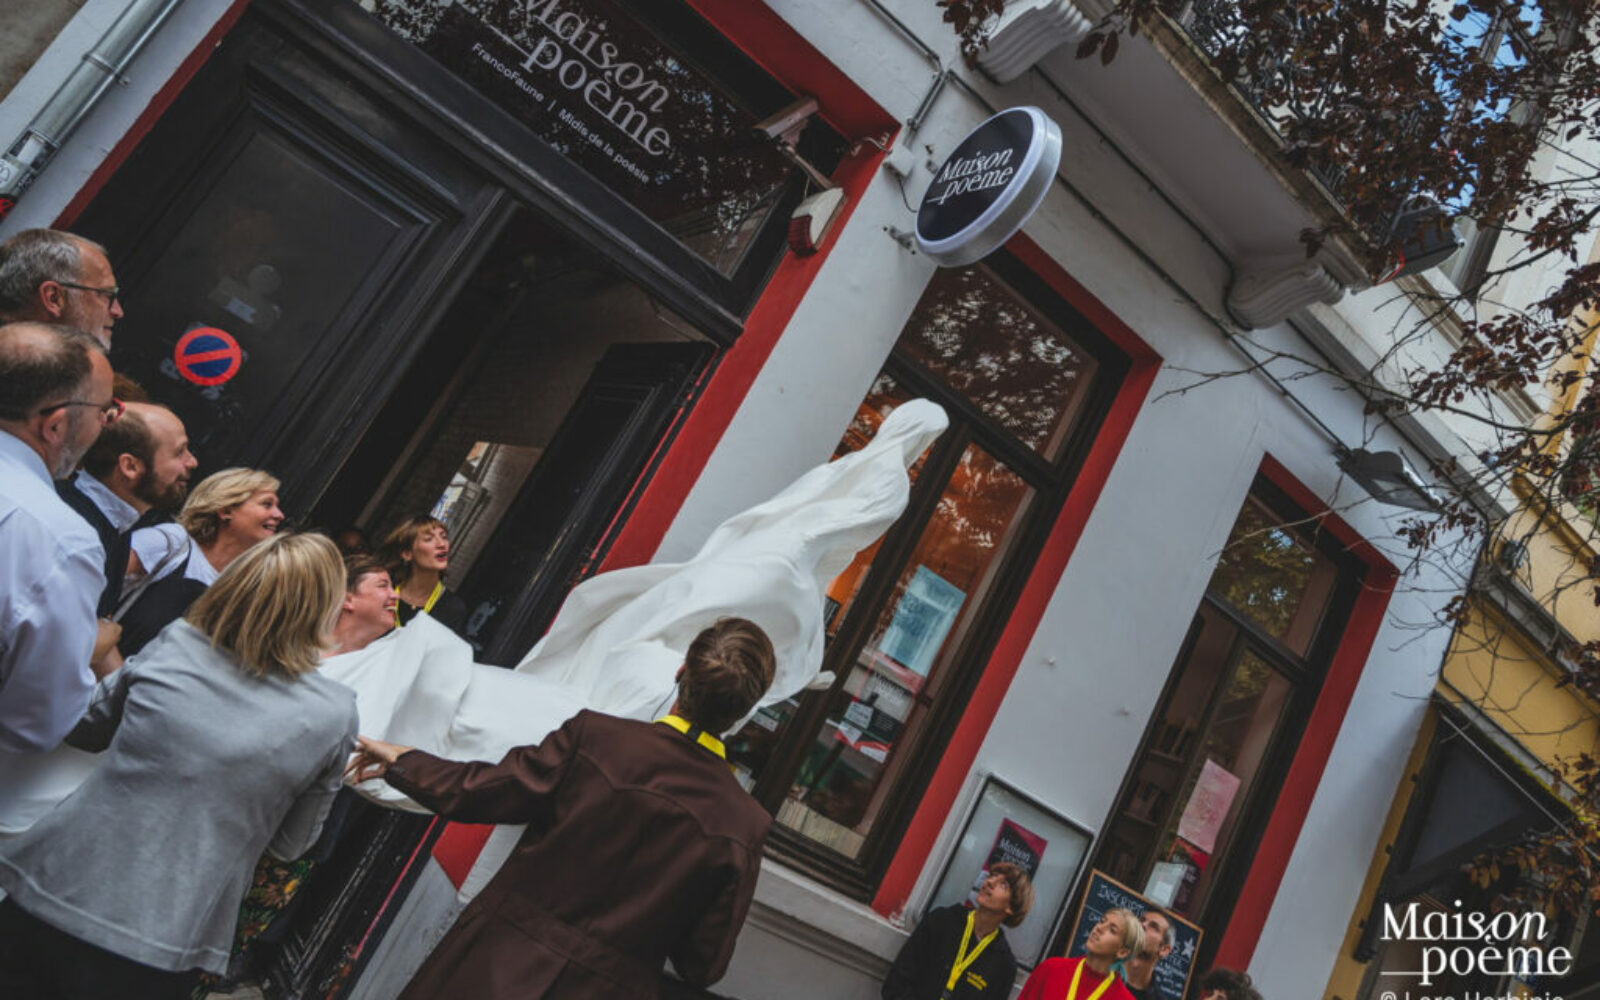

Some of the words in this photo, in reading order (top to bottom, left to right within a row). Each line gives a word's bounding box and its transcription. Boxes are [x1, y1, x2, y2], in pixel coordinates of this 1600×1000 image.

[472, 42, 545, 102] FrancoFaune
[558, 108, 588, 138] Midis
[588, 132, 603, 149] de
[603, 143, 616, 157] la
[937, 148, 1014, 185] Maison
